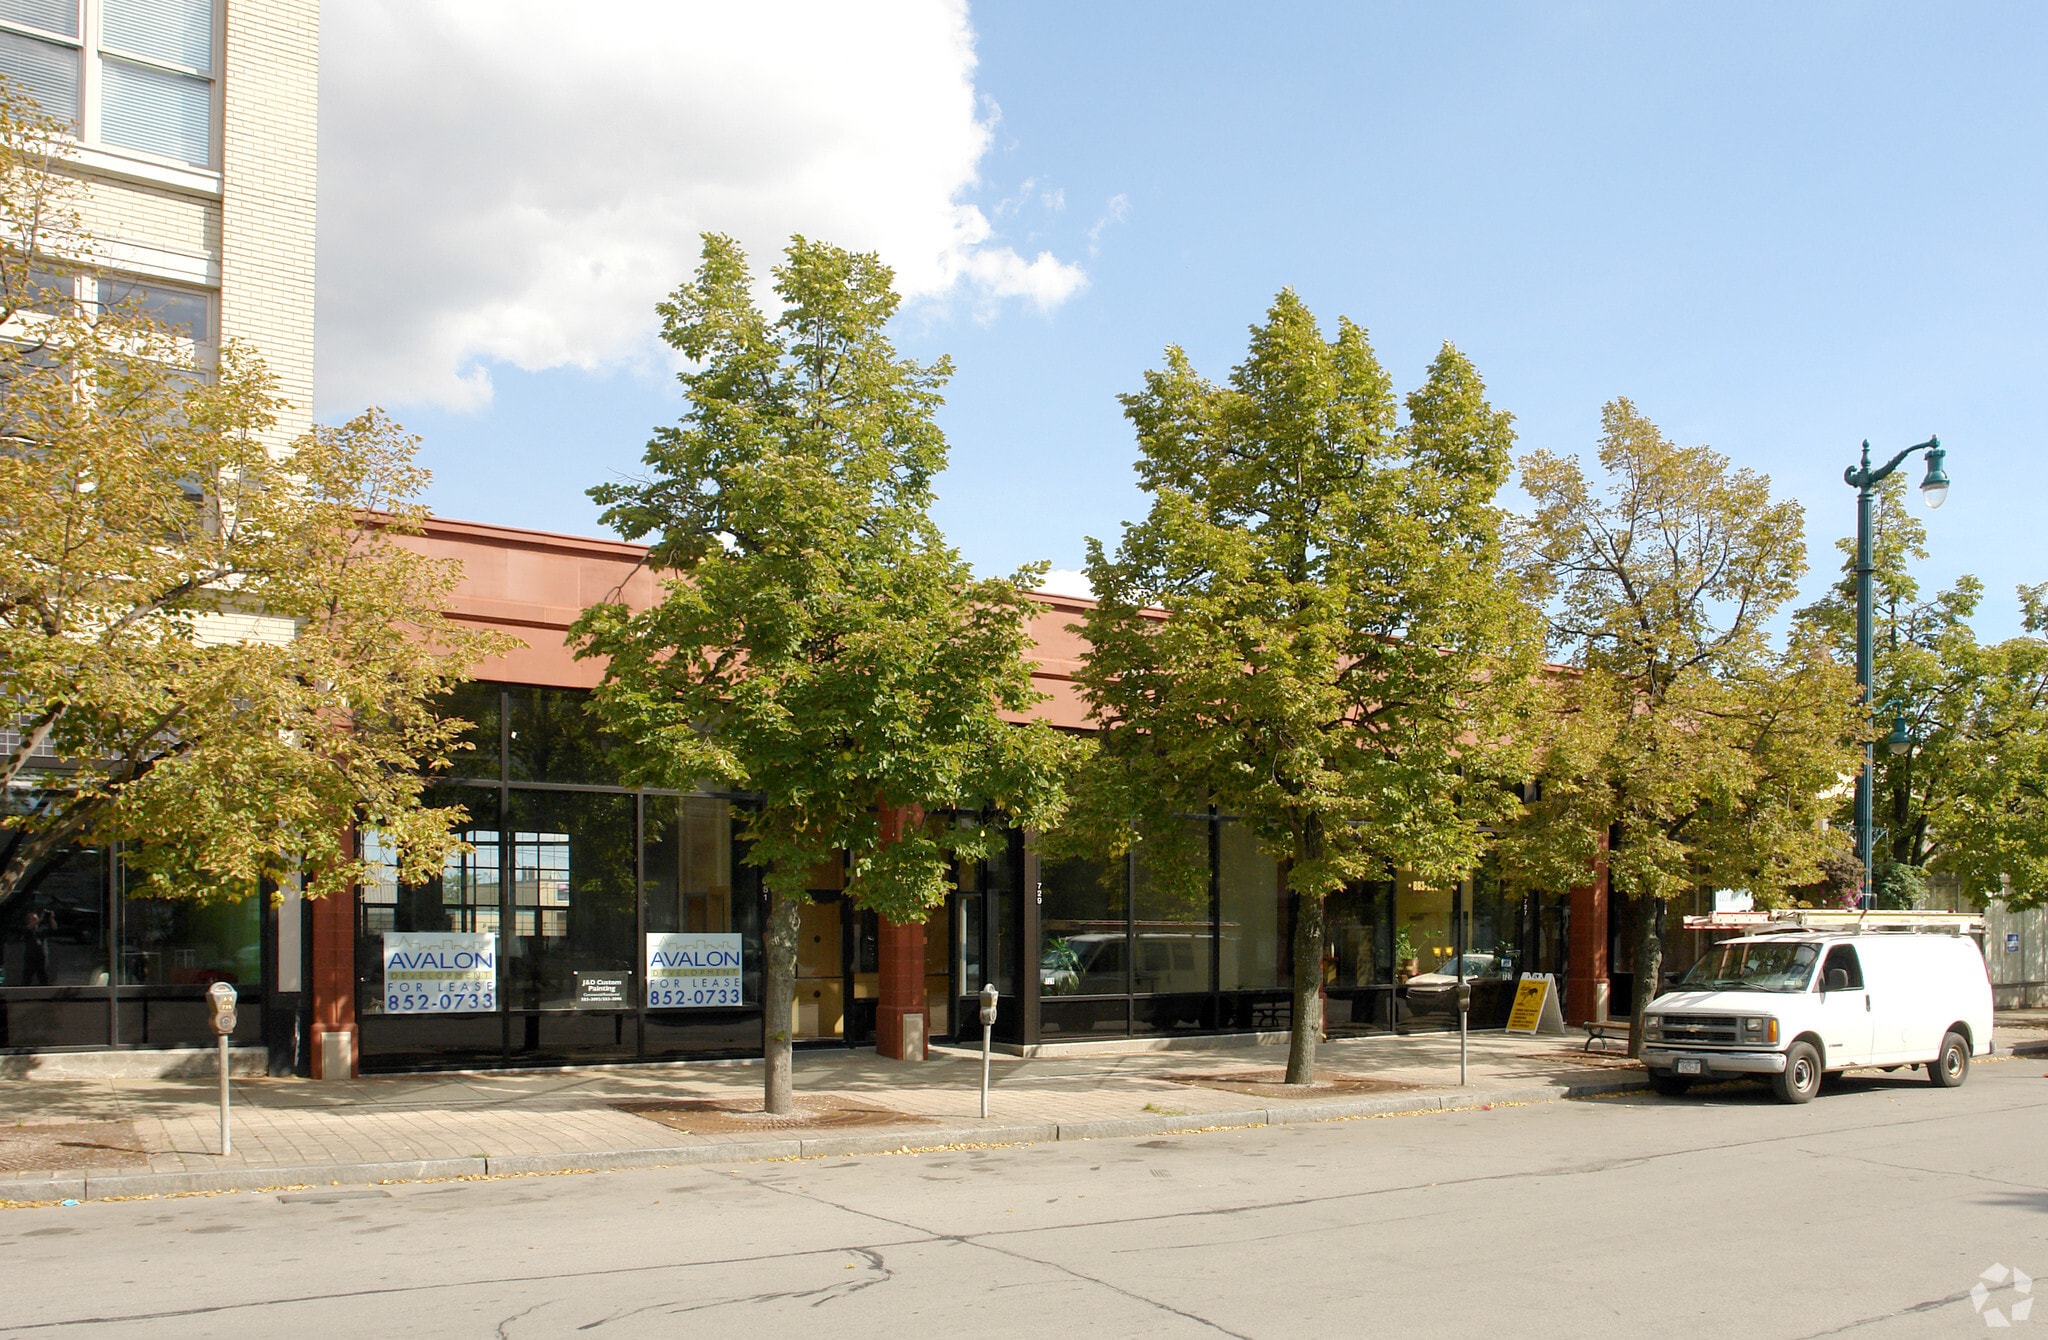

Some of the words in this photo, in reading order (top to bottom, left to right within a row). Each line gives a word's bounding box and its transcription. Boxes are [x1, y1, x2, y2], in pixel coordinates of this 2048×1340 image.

[388, 952, 493, 969] AVALON
[650, 951, 740, 967] AVALON
[653, 969, 736, 977] DEVELOPMENT
[388, 983, 423, 992] FOR
[438, 982, 493, 992] LEASE
[582, 979, 596, 987] J&D
[650, 980, 680, 988] FOR
[693, 978, 740, 987] LEASE
[588, 985, 616, 993] Painting
[388, 993, 493, 1010] 852-0733
[650, 989, 740, 1005] 852-0733
